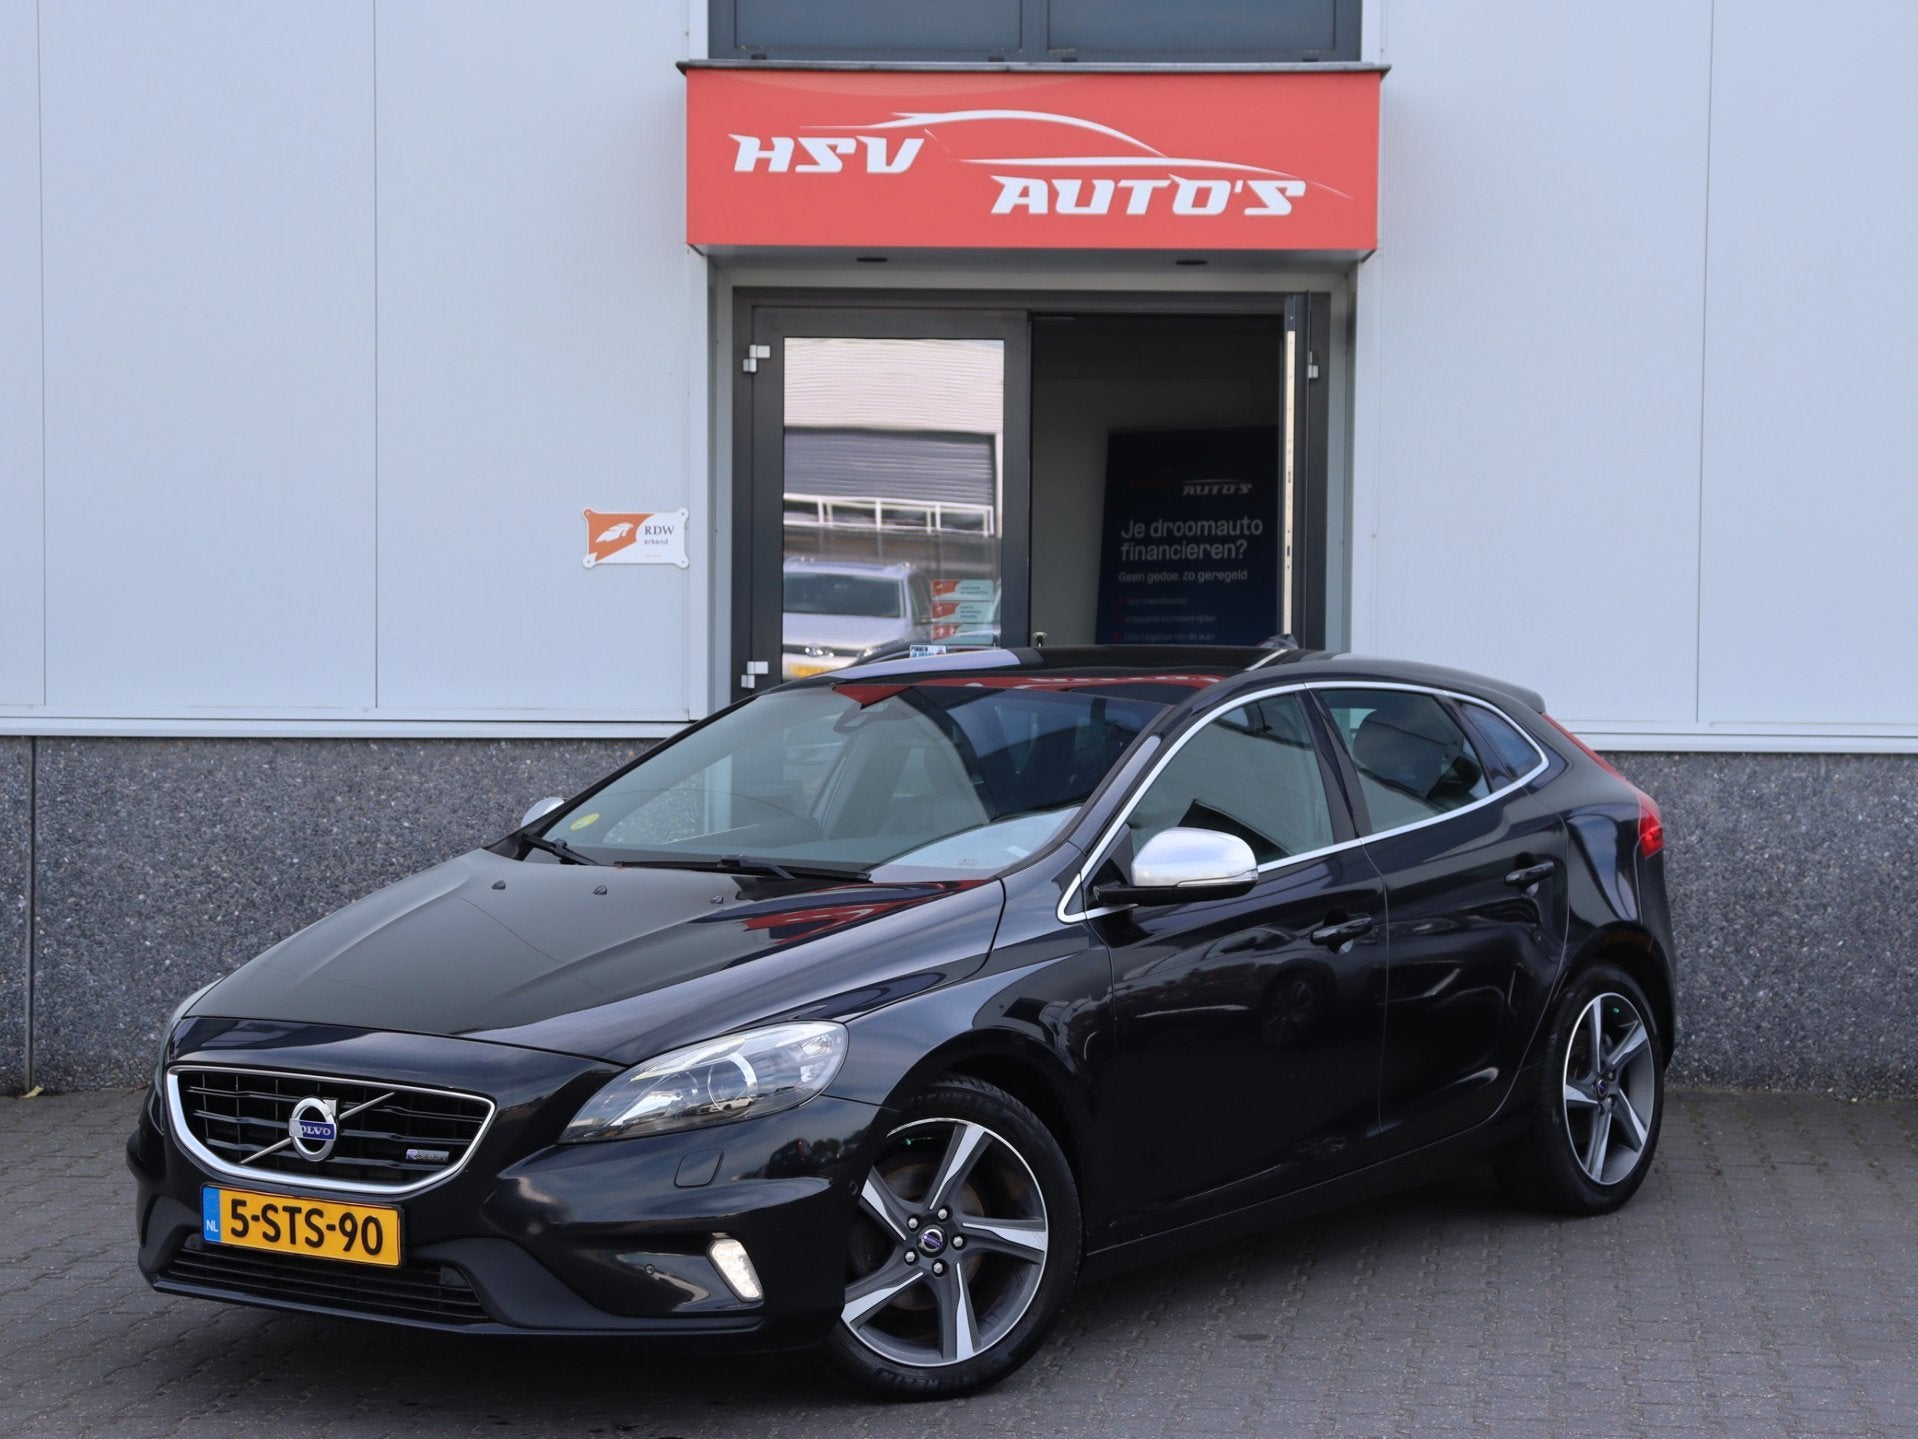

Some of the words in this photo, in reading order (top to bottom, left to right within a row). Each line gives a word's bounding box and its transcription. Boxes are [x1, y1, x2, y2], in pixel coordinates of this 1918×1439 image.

[728, 133, 925, 173] HSV
[990, 174, 1306, 216] AUTO'S
[644, 525, 675, 535] RDW
[1121, 520, 1146, 539] Je
[1150, 516, 1264, 537] droomauto
[1119, 539, 1248, 561] financieren?
[1118, 572, 1145, 582] Geen
[1182, 571, 1195, 581] zo
[1198, 569, 1248, 583] geregeld
[206, 1219, 219, 1232] NL
[230, 1198, 384, 1256] 5-STS-90
